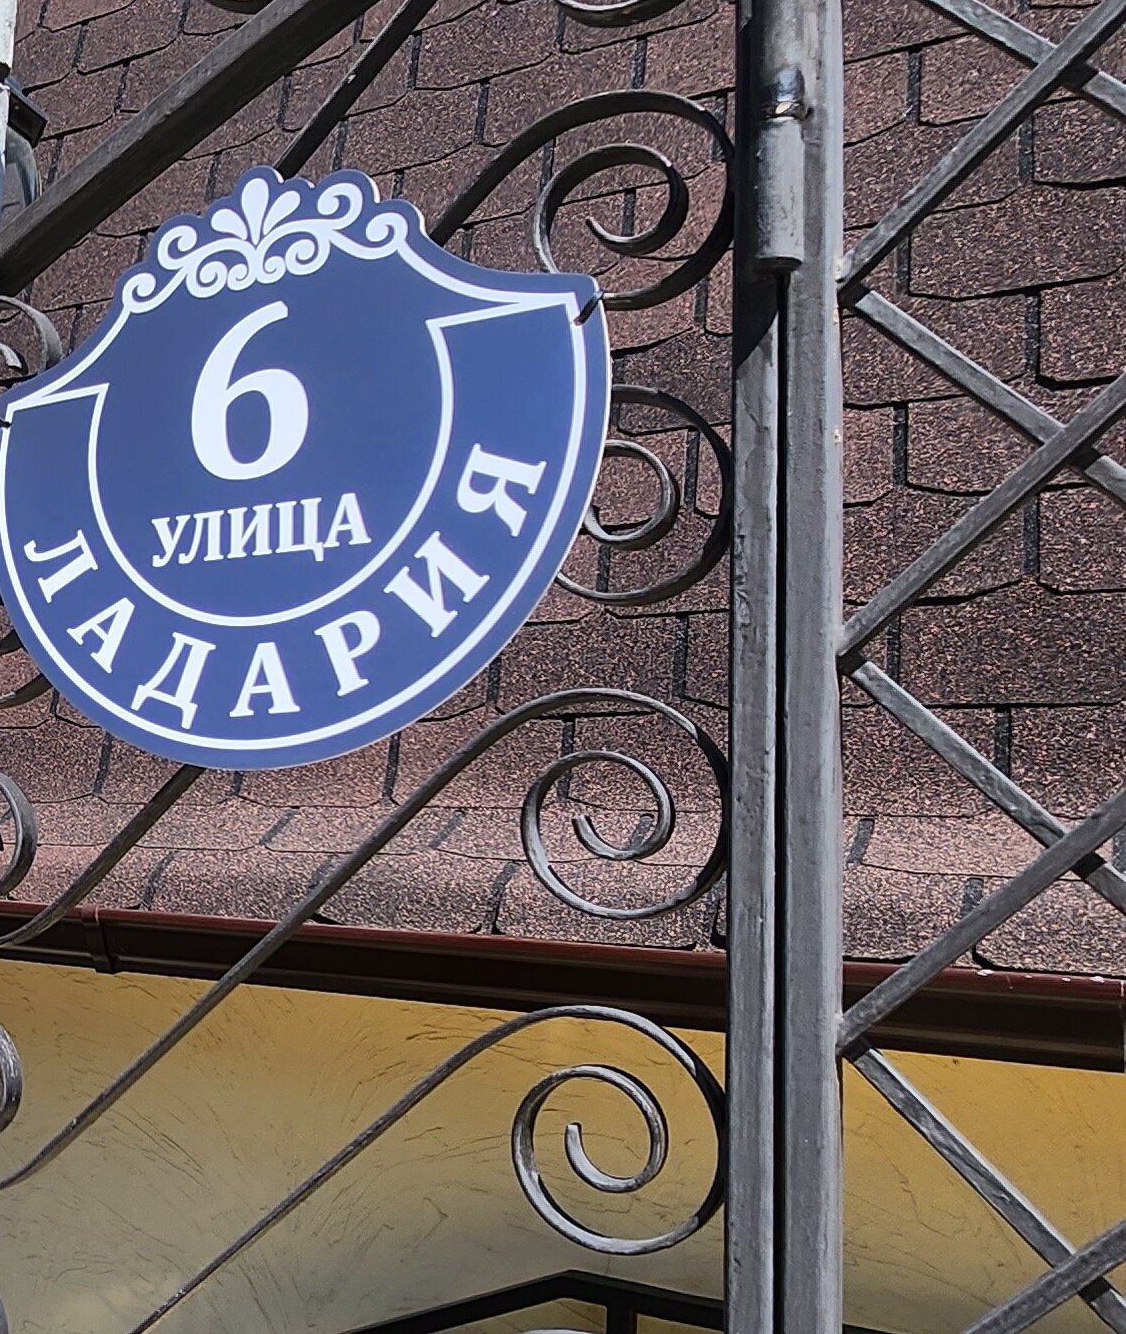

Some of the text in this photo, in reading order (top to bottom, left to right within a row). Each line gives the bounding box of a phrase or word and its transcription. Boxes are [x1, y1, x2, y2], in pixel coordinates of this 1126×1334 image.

[191, 300, 309, 481] 6
[24, 443, 547, 730] ЛАДАРИЯ
[150, 493, 372, 568] УЛИЦА
